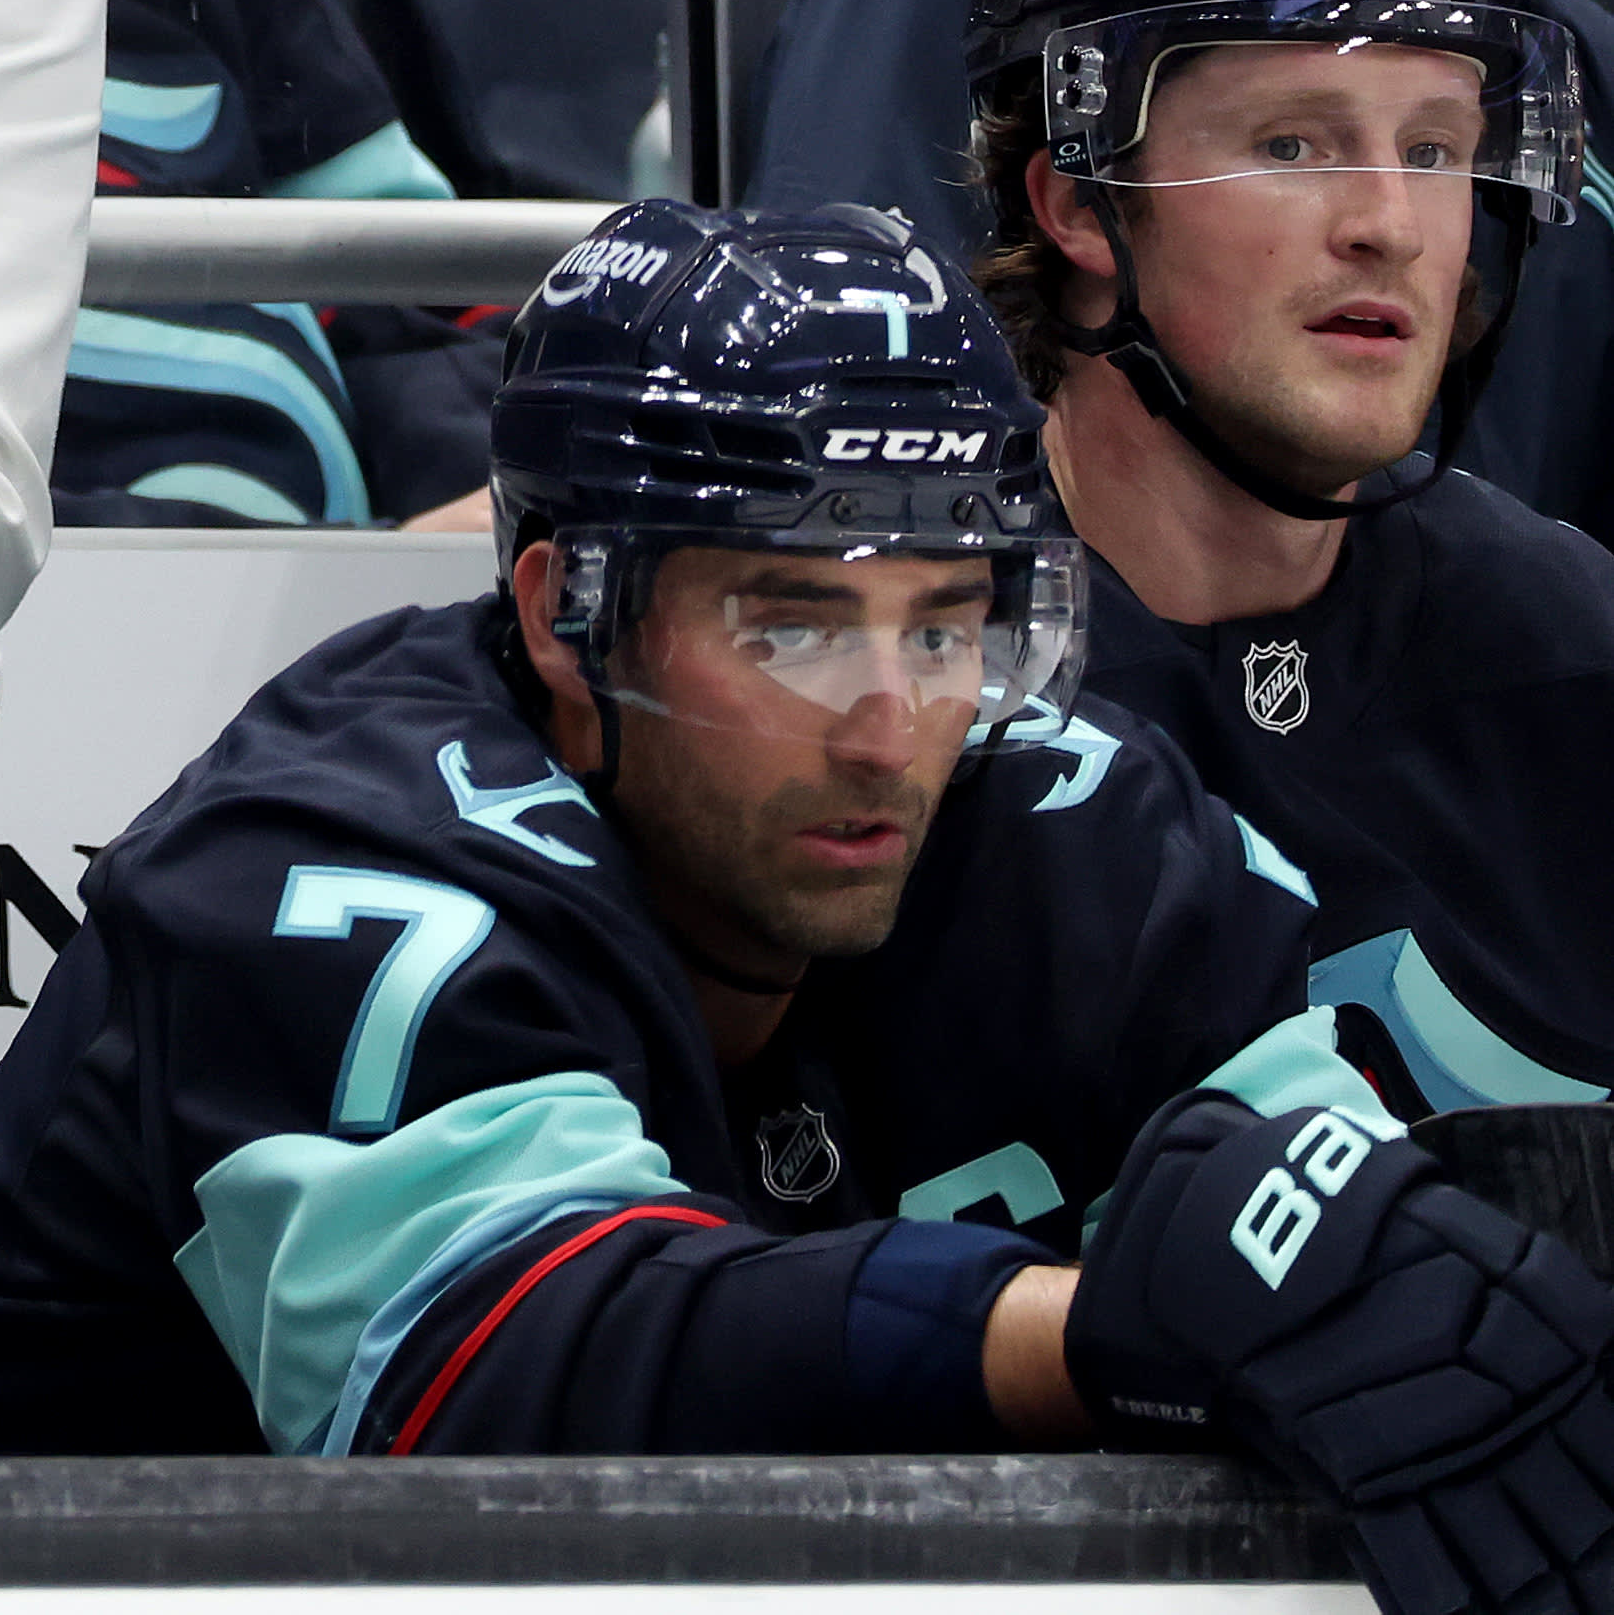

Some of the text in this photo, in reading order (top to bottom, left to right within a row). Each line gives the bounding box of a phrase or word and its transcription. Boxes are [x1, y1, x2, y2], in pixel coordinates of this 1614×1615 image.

[840, 288, 908, 359] 7
[822, 429, 988, 463] CCM
[1258, 664, 1294, 716] NHL
[273, 865, 497, 1135] 7
[779, 1131, 816, 1186] NHL
[1112, 1396, 1208, 1424] EBERLE
